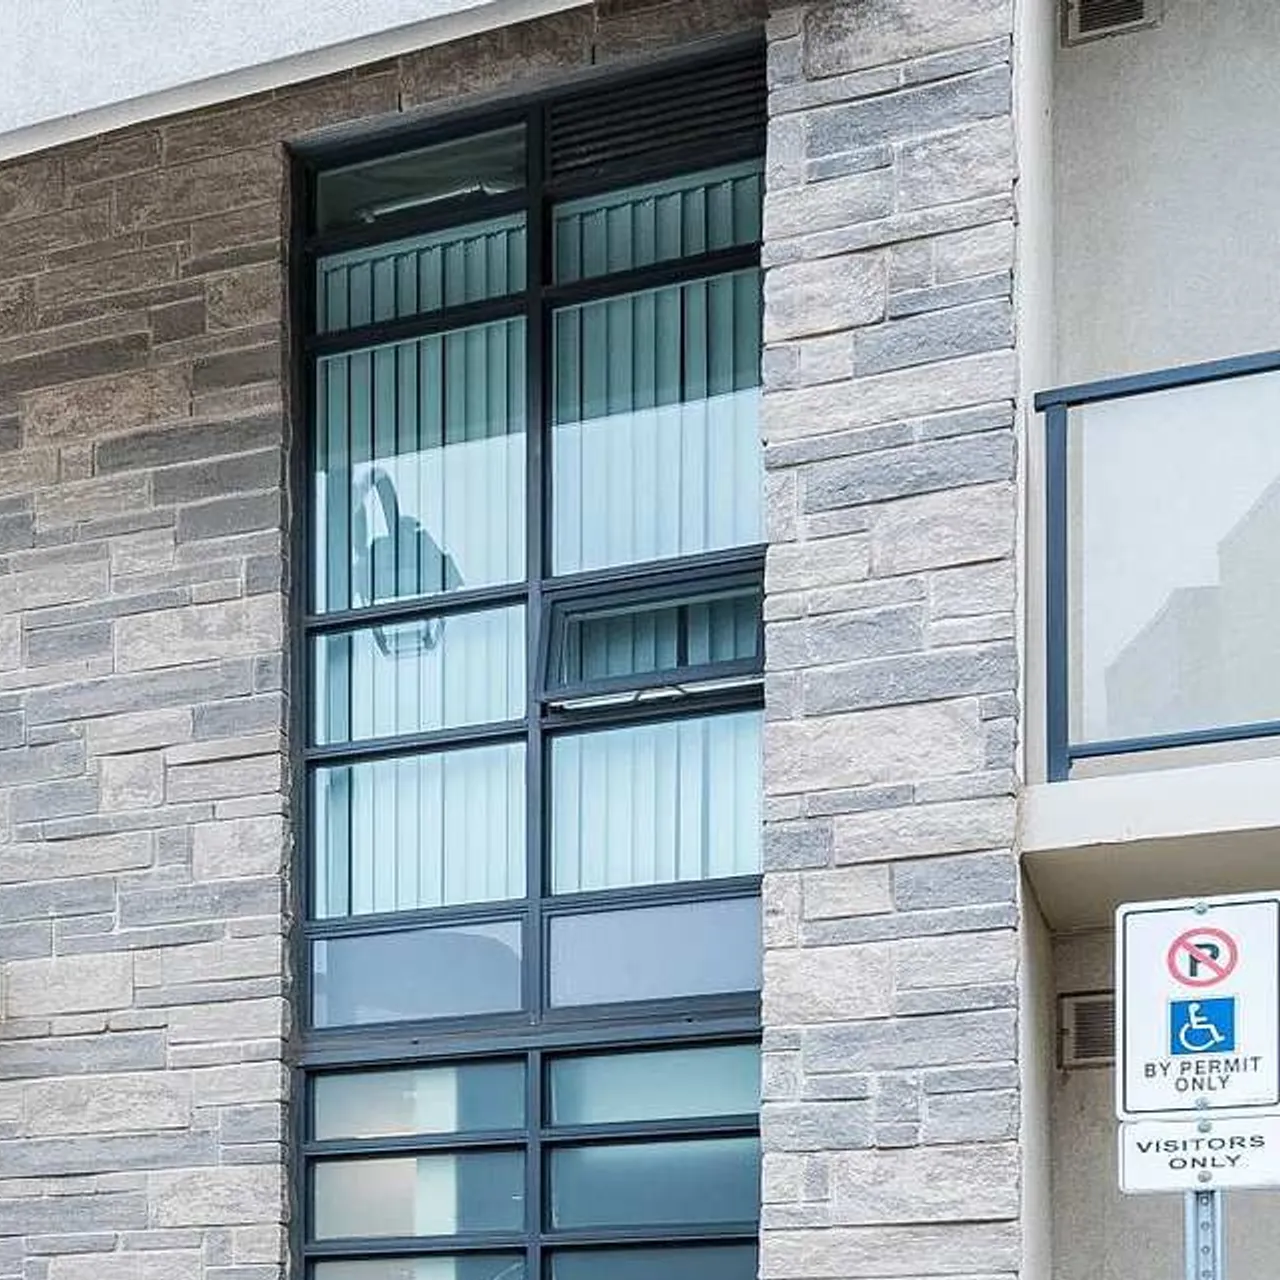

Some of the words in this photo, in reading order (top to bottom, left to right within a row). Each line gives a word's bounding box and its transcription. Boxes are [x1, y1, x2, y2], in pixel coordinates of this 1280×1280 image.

[1144, 1061, 1172, 1078] BY
[1179, 1056, 1263, 1076] PERMIT
[1174, 1075, 1232, 1093] ONLY
[1136, 1135, 1265, 1153] VISITORS
[1168, 1154, 1241, 1169] ONLY
